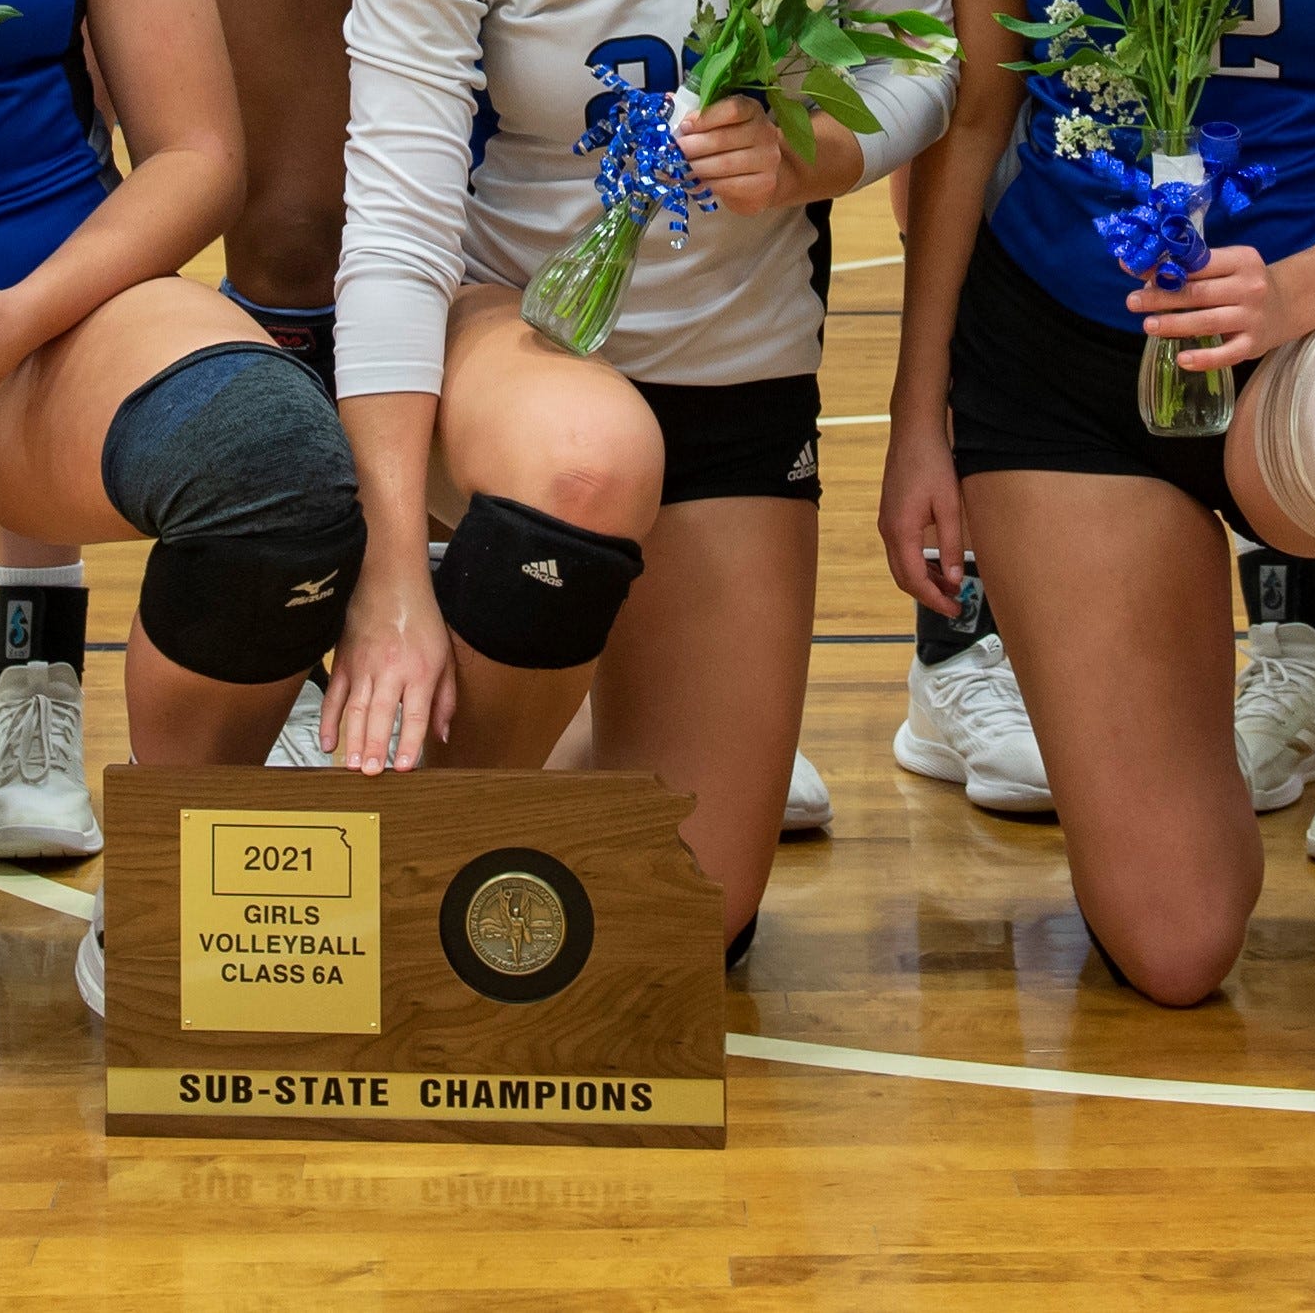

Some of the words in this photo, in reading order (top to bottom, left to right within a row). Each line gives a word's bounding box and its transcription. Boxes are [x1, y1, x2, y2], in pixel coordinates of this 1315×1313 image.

[522, 564, 563, 587] adidas
[244, 846, 313, 871] 2021
[244, 904, 320, 925] GIRLS
[199, 933, 366, 956] VOLLEYBALL
[221, 963, 305, 984] CLASS
[312, 965, 344, 985] 6A
[179, 1074, 389, 1106] SUB-STATE
[420, 1078, 653, 1112] CHAMPIONS
